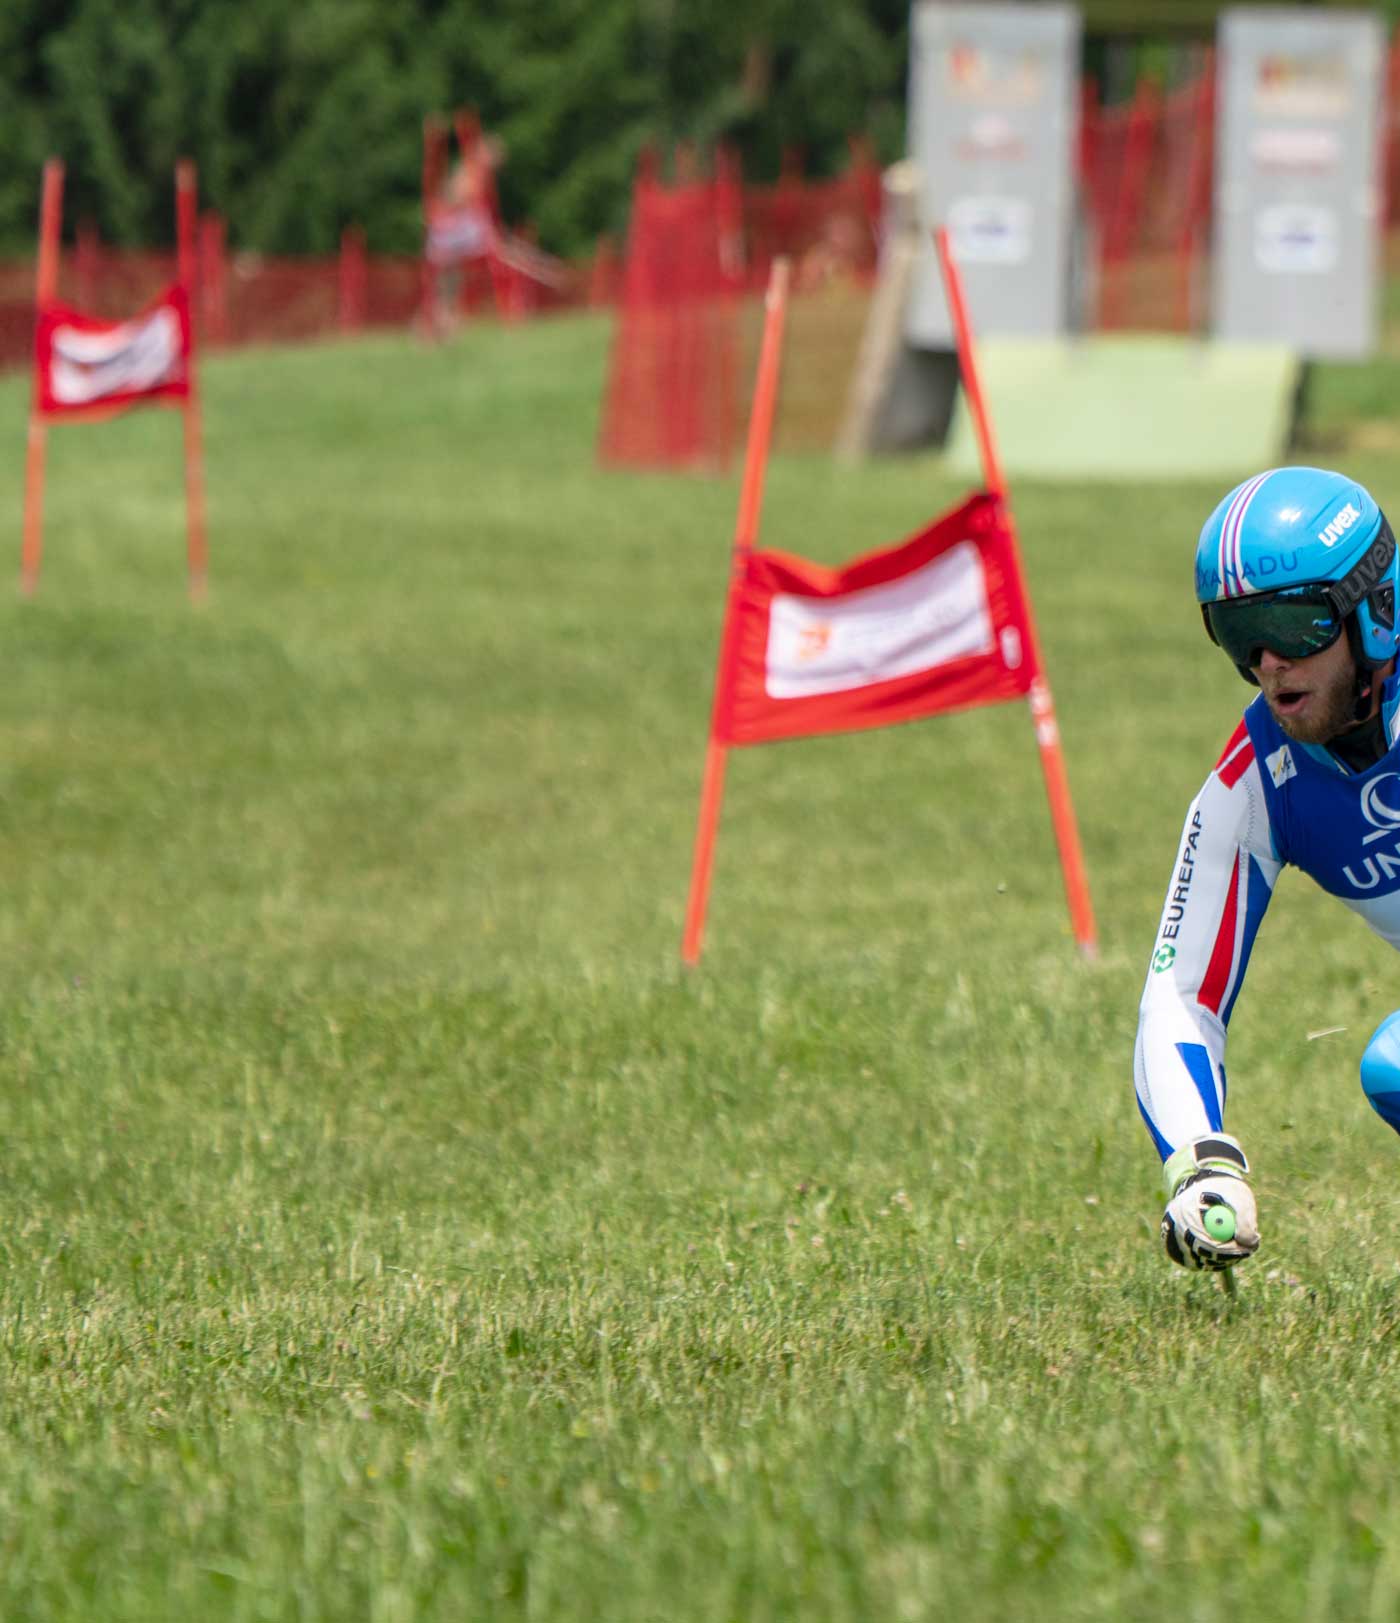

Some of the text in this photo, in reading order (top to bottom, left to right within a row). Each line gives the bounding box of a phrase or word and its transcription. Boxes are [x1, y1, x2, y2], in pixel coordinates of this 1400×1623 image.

[1317, 502, 1361, 548] uvex
[1199, 550, 1298, 588] XANADU
[1343, 528, 1396, 600] uvex
[1162, 810, 1203, 940] EUREPAP
